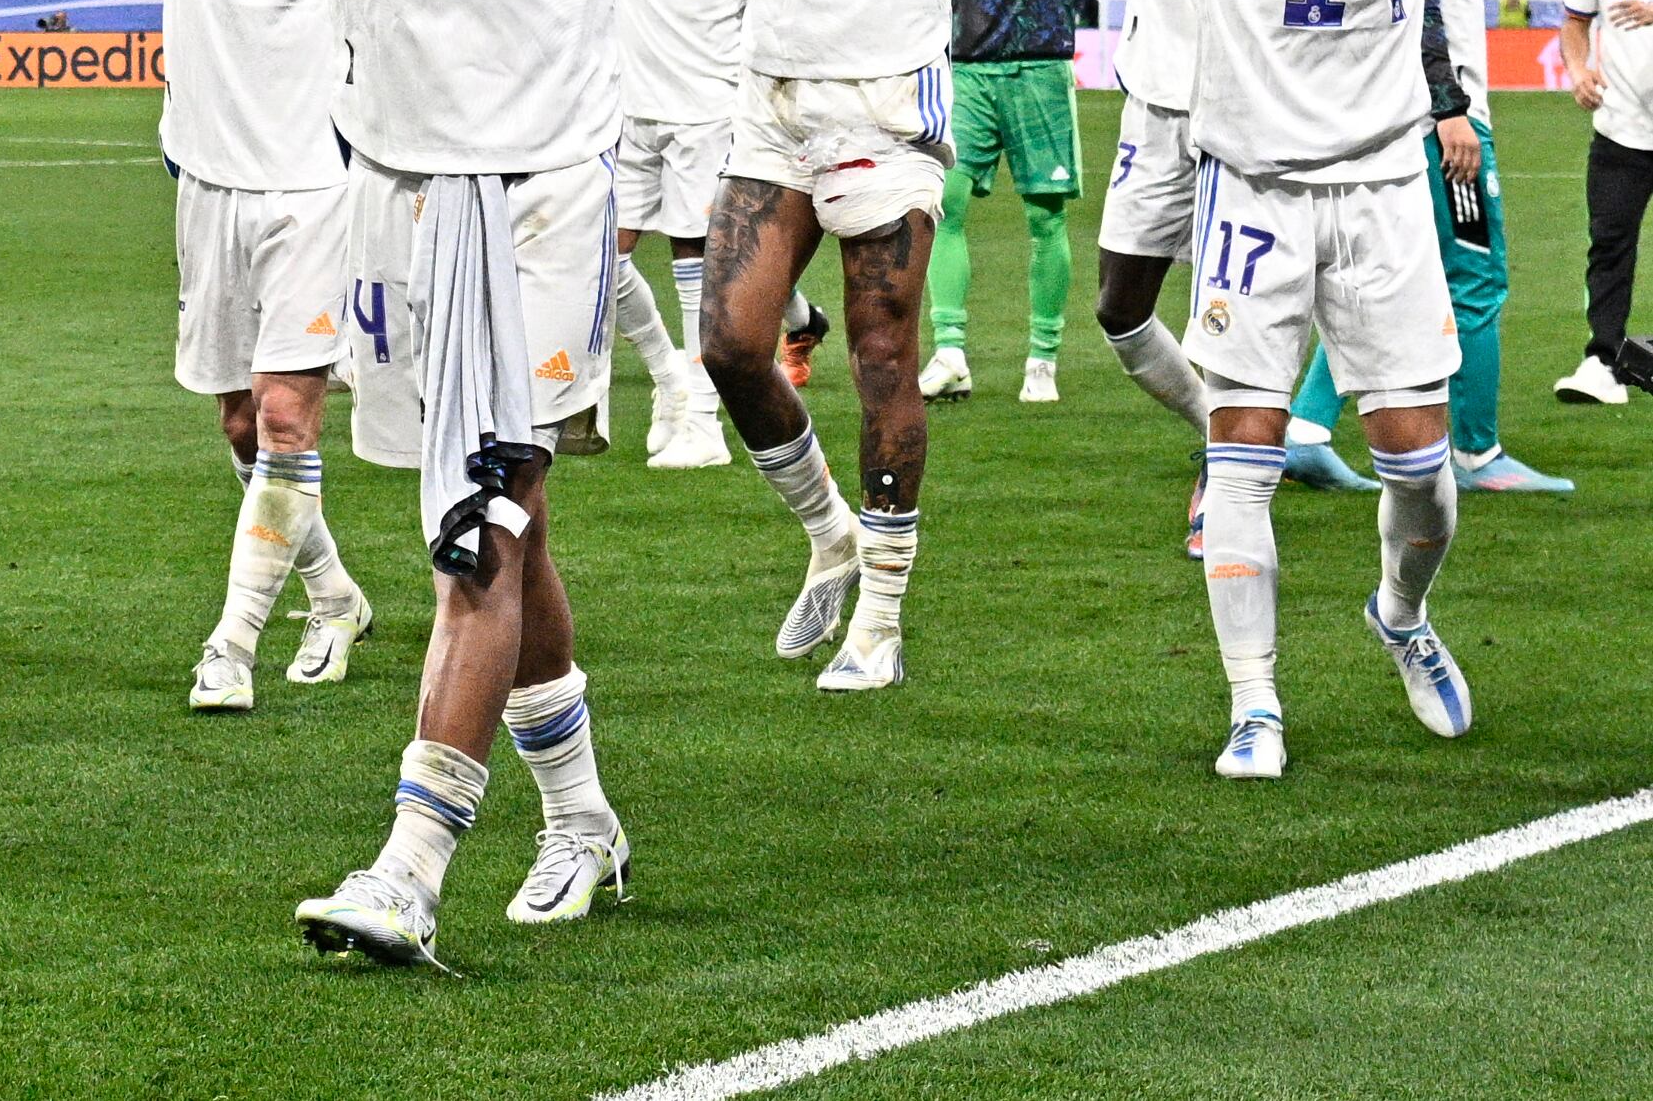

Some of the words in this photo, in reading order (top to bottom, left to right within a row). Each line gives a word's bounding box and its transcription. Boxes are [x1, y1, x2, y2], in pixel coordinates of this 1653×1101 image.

[1207, 220, 1276, 296] 17
[351, 278, 391, 364] 4
[535, 368, 574, 382] adidas
